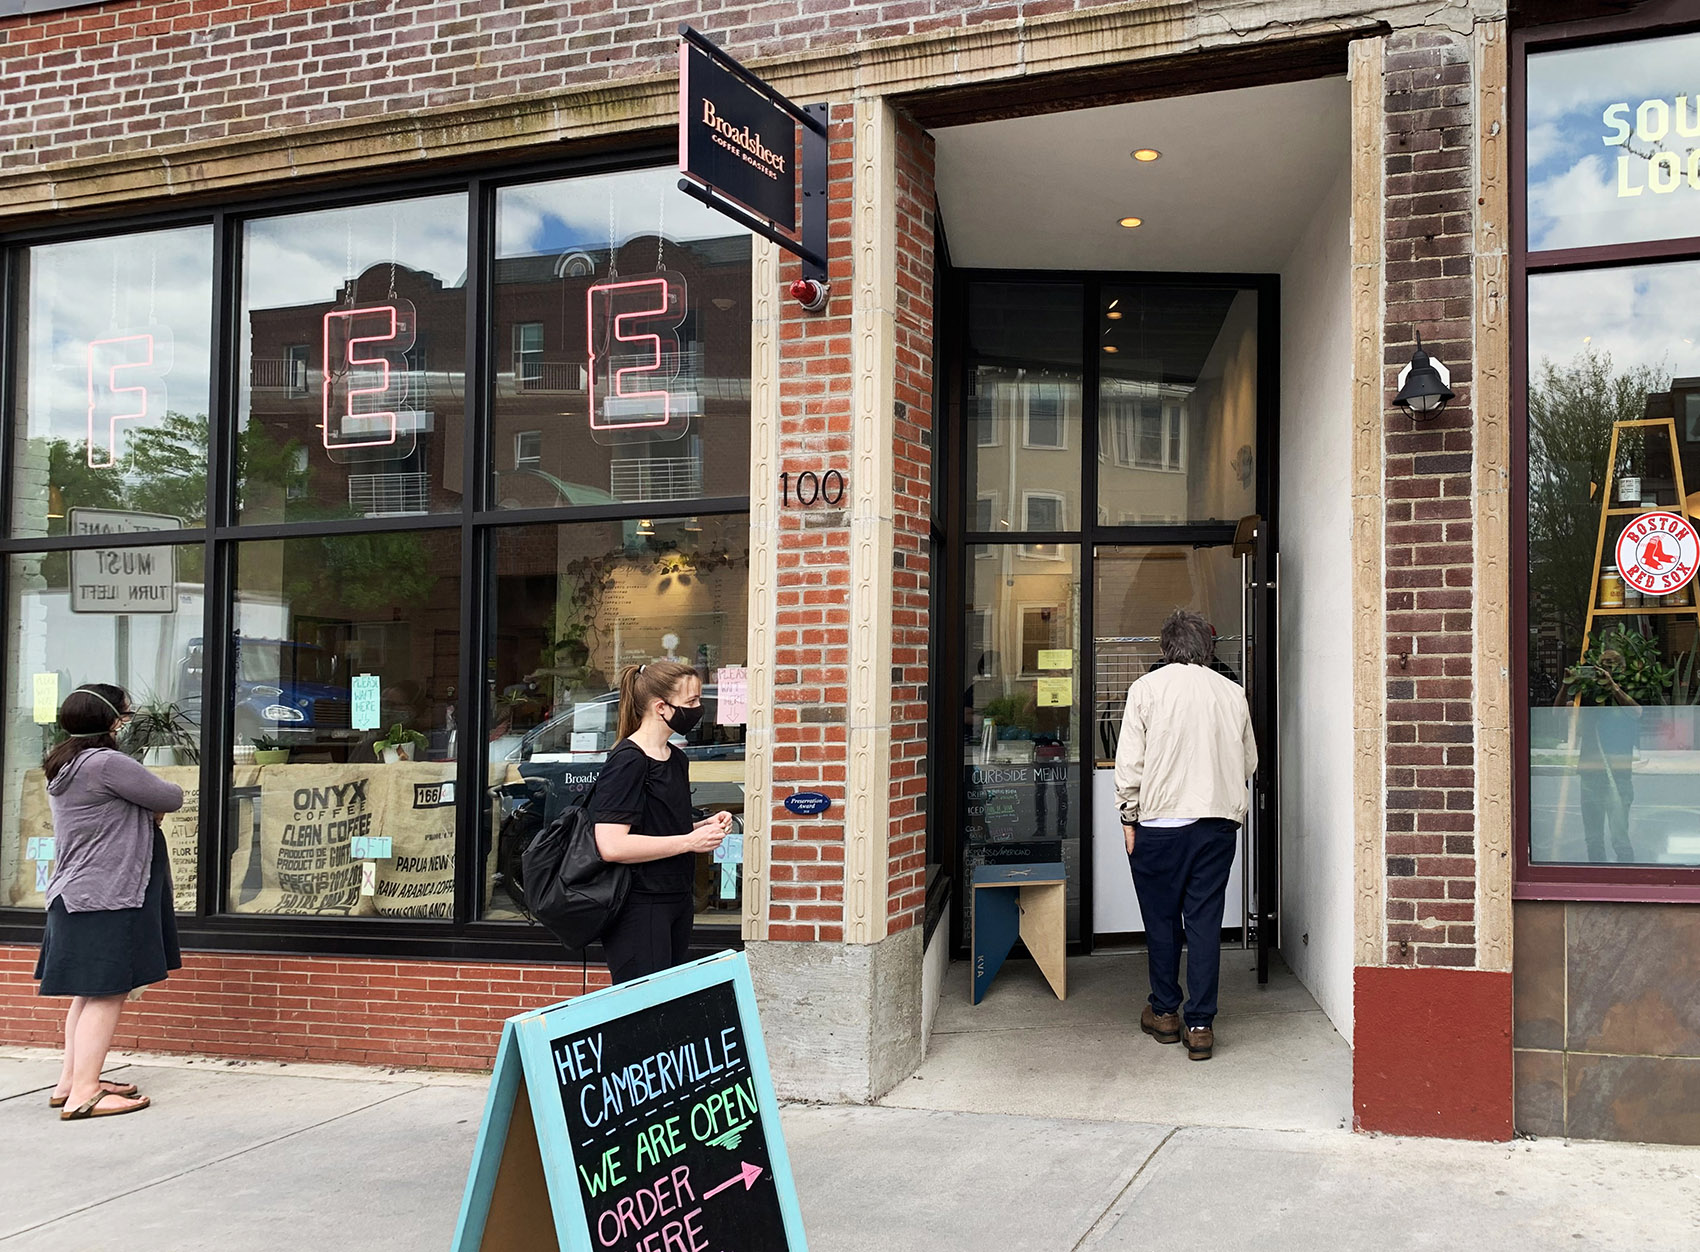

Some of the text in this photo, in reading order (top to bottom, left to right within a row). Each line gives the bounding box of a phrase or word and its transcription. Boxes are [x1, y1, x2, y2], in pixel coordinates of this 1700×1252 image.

[1601, 95, 1700, 146] SOU
[702, 98, 786, 173] Broadsheet
[711, 134, 778, 180] COFFEE ROASTERS
[779, 470, 844, 506] 100
[1627, 517, 1690, 543] BOSTON
[1626, 562, 1691, 588] RED SOX
[565, 771, 600, 784] Broads
[972, 766, 1068, 785] CURBSIDE MENU
[293, 778, 369, 810] ONYX
[293, 801, 367, 821] COFFEE
[967, 806, 985, 814] ICED
[281, 812, 373, 847] CLEAN COFFEE
[172, 847, 191, 856] FLOR
[277, 858, 327, 870] PRODUCT OF
[279, 847, 314, 859] PRODUCTO
[316, 847, 327, 857] DE
[395, 856, 428, 872] PAPUA
[428, 854, 449, 871] NEW
[377, 880, 400, 897] RAW
[398, 882, 436, 898] ARABICA
[554, 1032, 603, 1085] HEY
[580, 1026, 741, 1128] CAMBERVILLE
[579, 1077, 758, 1198] WE ARE OPEN
[598, 1165, 696, 1247] ORDER
